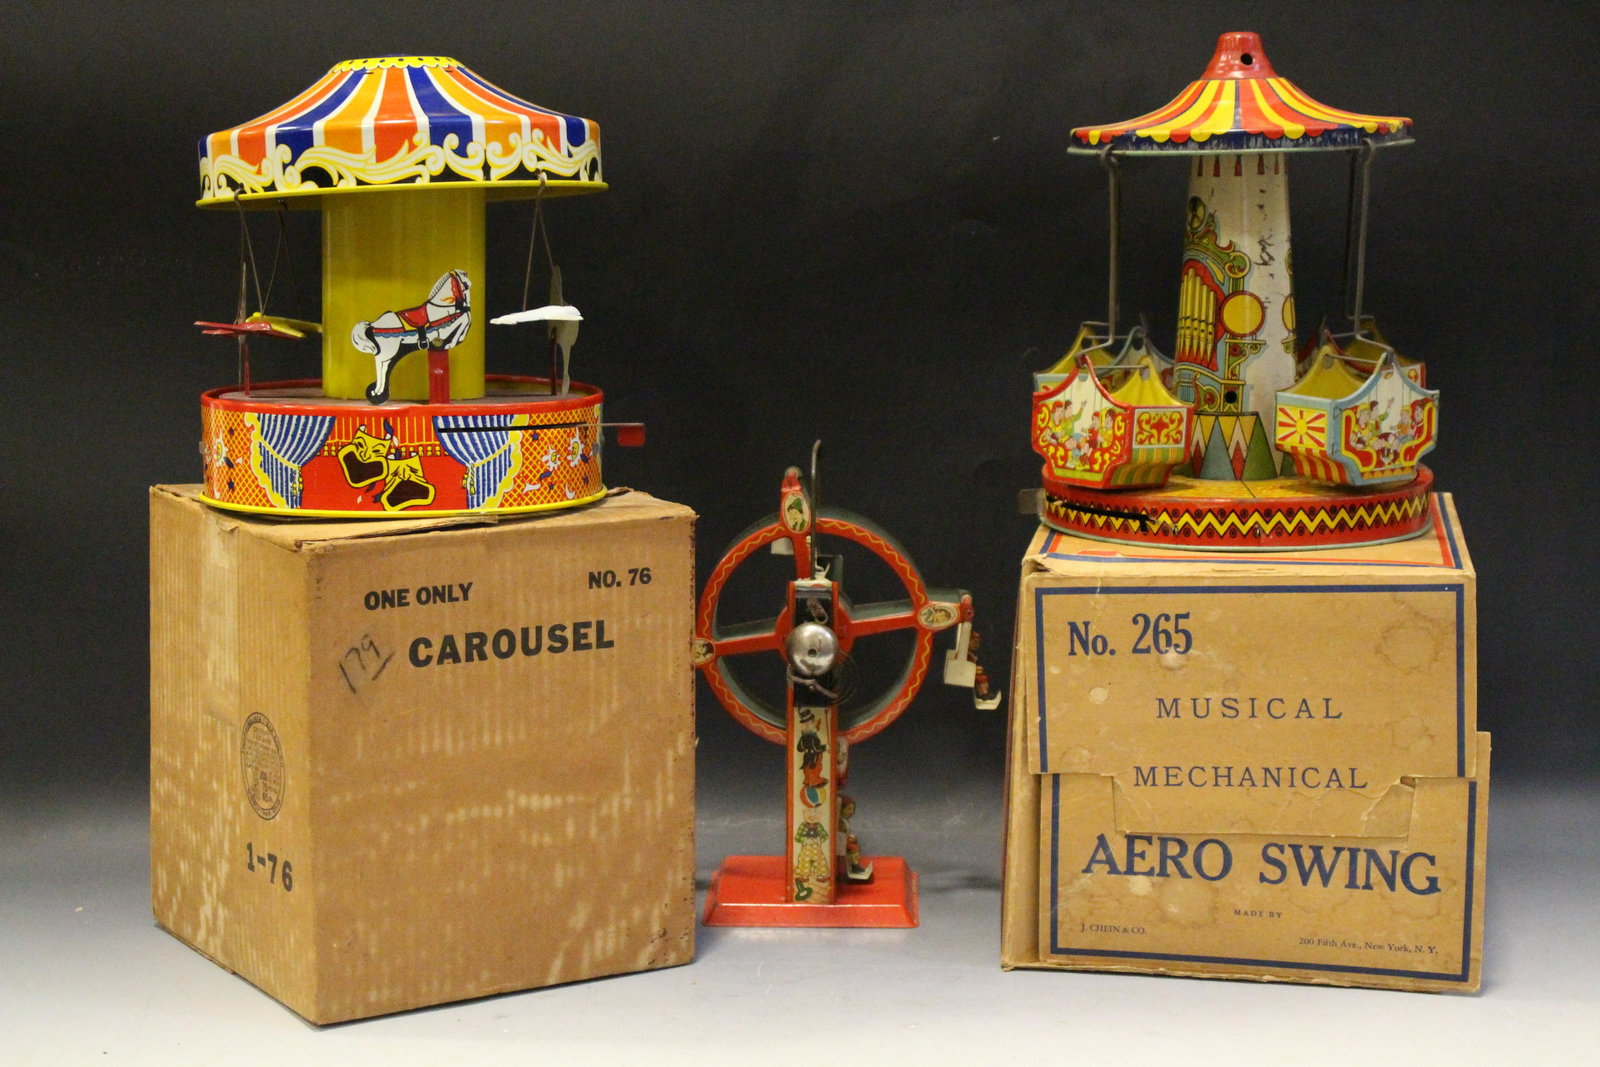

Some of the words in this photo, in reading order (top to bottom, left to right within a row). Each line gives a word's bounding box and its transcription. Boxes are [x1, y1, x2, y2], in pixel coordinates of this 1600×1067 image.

[588, 569, 621, 589] NO.
[628, 567, 652, 586] 76
[364, 588, 410, 611] ONE
[416, 582, 473, 606] ONLY
[408, 619, 615, 668] CAROUSEL
[1067, 620, 1117, 656] No.
[1131, 611, 1193, 655] 265
[1155, 697, 1343, 720] MUSICAL
[1133, 765, 1368, 789] MECHANICAL
[246, 841, 293, 892] 1-76
[1081, 832, 1233, 882] AERO
[1259, 842, 1442, 896] SWING
[1233, 909, 1264, 918] MADE
[1269, 911, 1283, 919] BY
[1089, 923, 1121, 934] CHEIN
[1122, 926, 1130, 934] &
[1131, 926, 1147, 935] CO.
[1298, 937, 1315, 946] 200
[1317, 938, 1338, 947] Fifth
[1364, 941, 1384, 950] New
[1387, 943, 1412, 954] York,
[1414, 945, 1425, 954] N.
[1427, 946, 1439, 955] Y.
